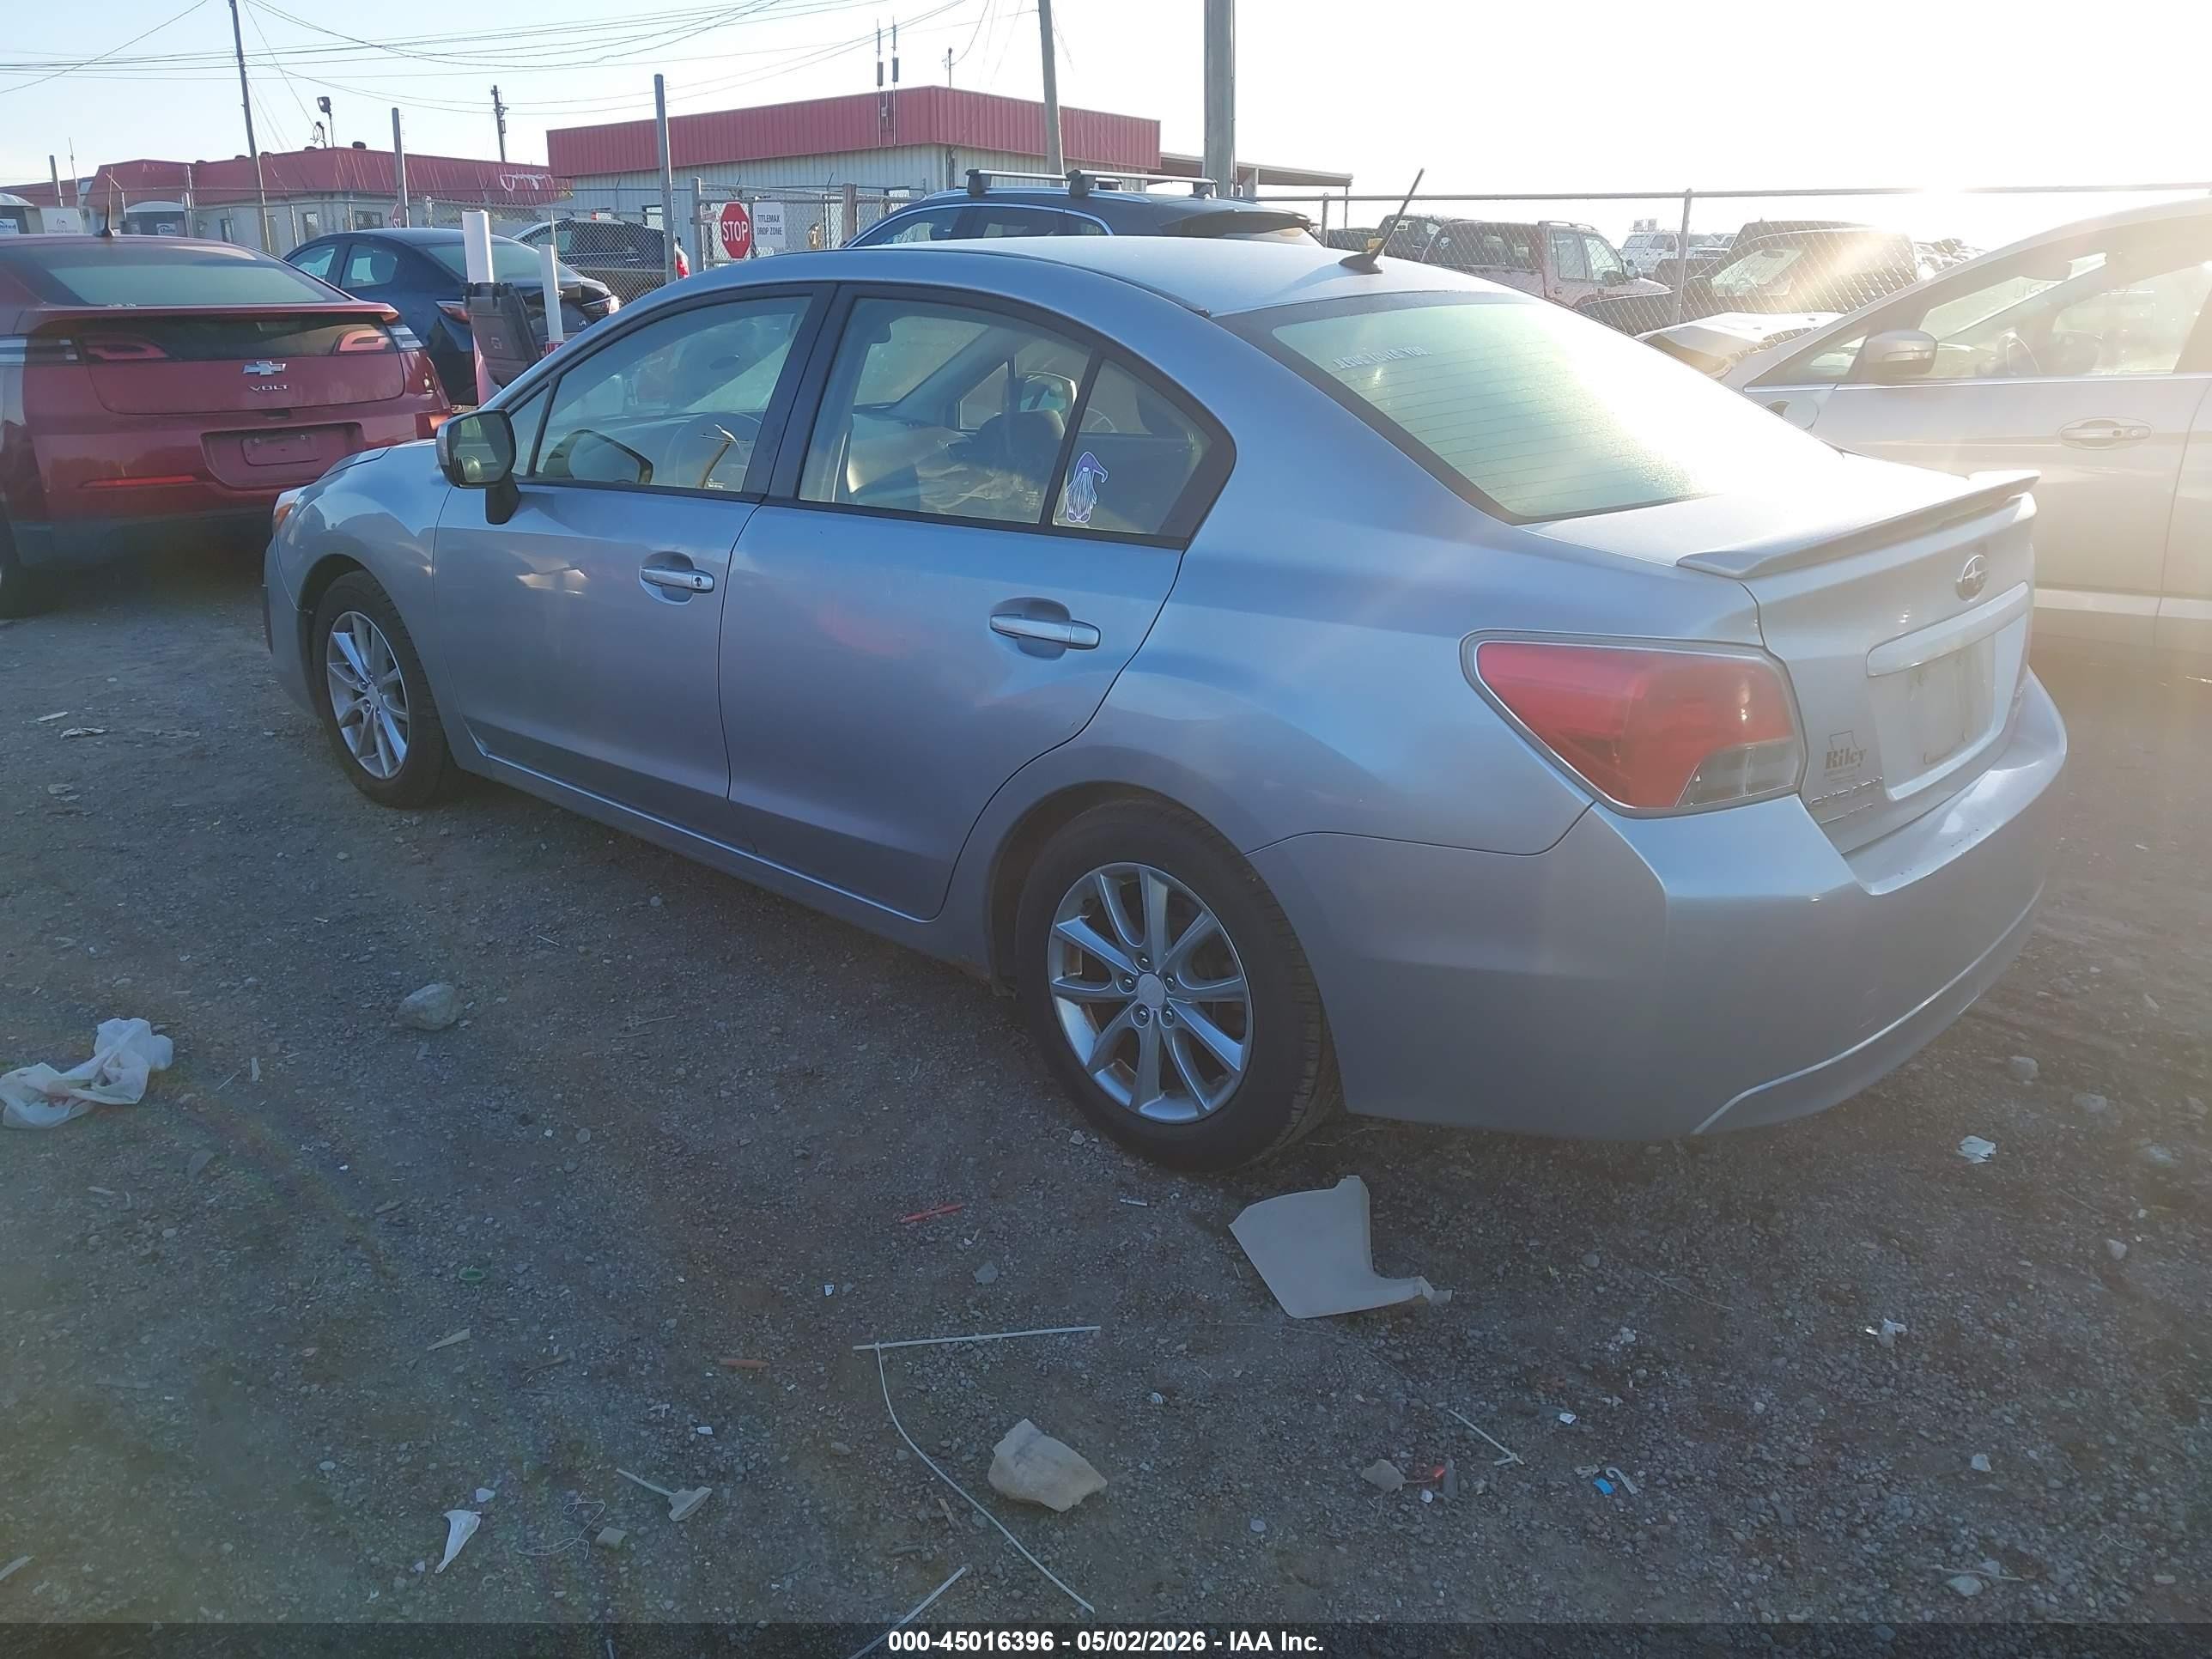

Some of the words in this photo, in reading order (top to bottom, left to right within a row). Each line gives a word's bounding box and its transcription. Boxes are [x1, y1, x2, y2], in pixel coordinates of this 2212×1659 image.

[721, 221, 748, 241] STOP
[757, 226, 769, 235] DROP
[769, 226, 782, 235] ZONE
[1826, 747, 1868, 770] Riley
